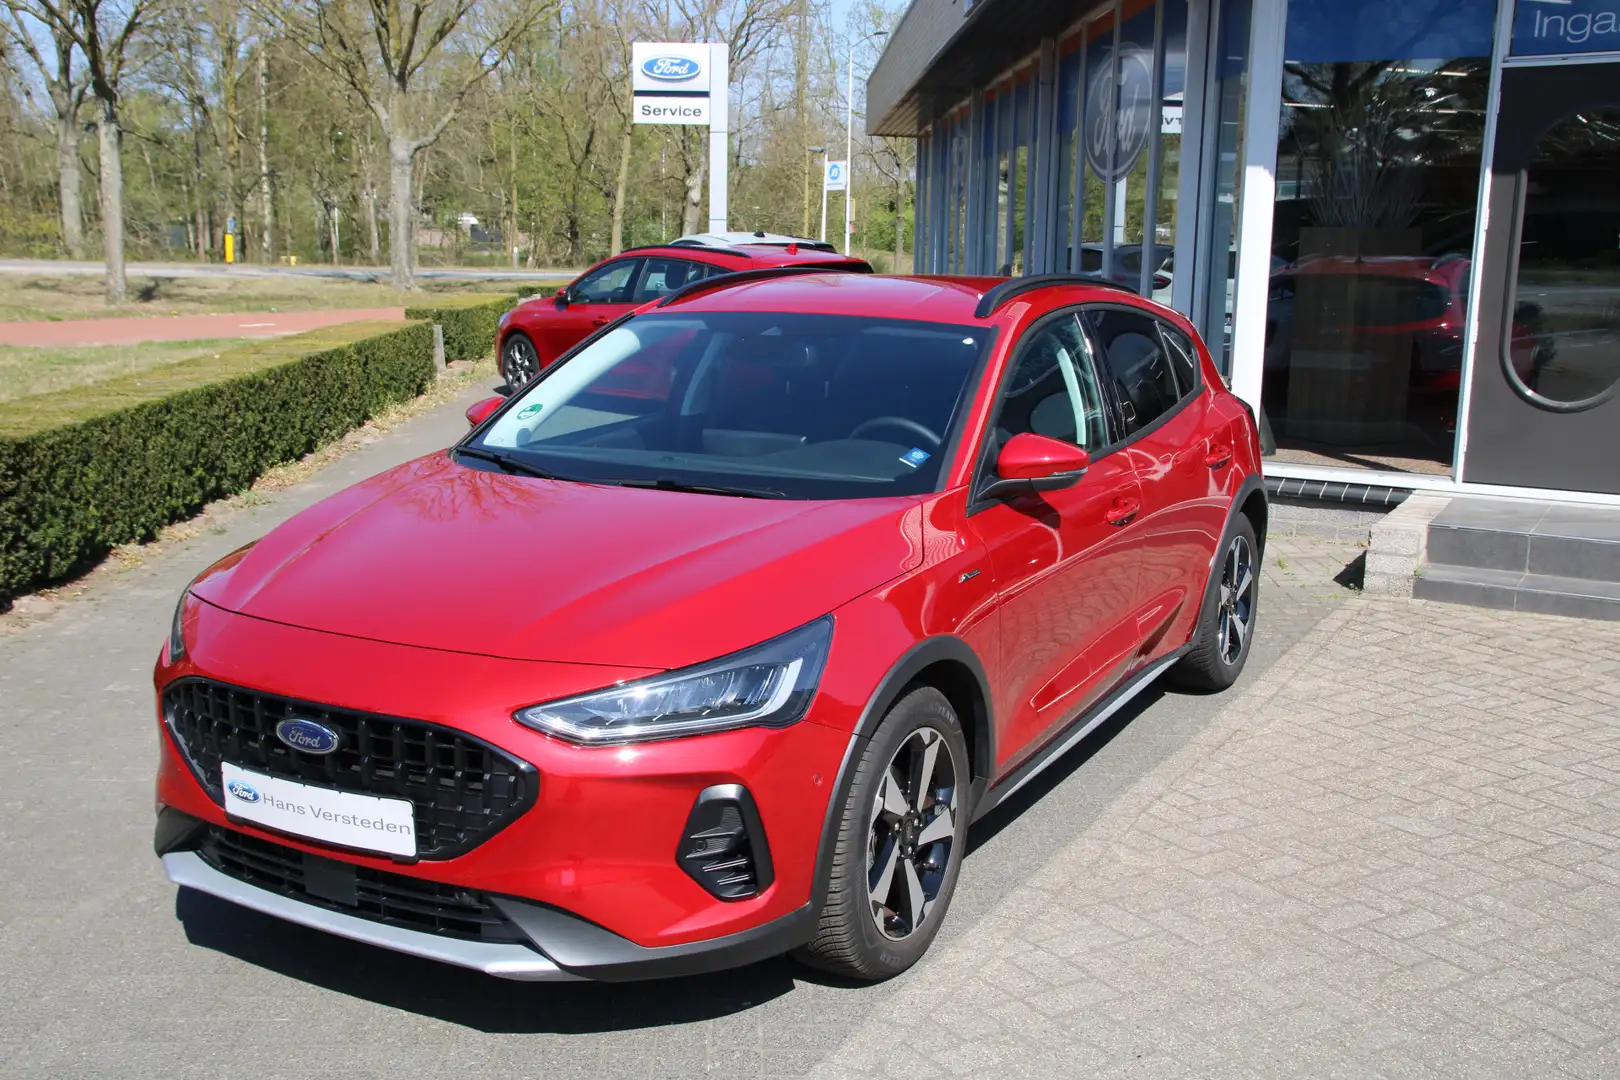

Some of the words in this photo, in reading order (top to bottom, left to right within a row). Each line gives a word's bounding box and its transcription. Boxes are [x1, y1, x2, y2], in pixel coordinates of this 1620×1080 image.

[1534, 9, 1620, 43] Inga
[653, 57, 690, 73] Ford
[641, 104, 702, 117] Service
[288, 727, 321, 748] Ford
[231, 783, 255, 801] Ford
[263, 793, 306, 815] Hans
[309, 805, 411, 835] Versteden
